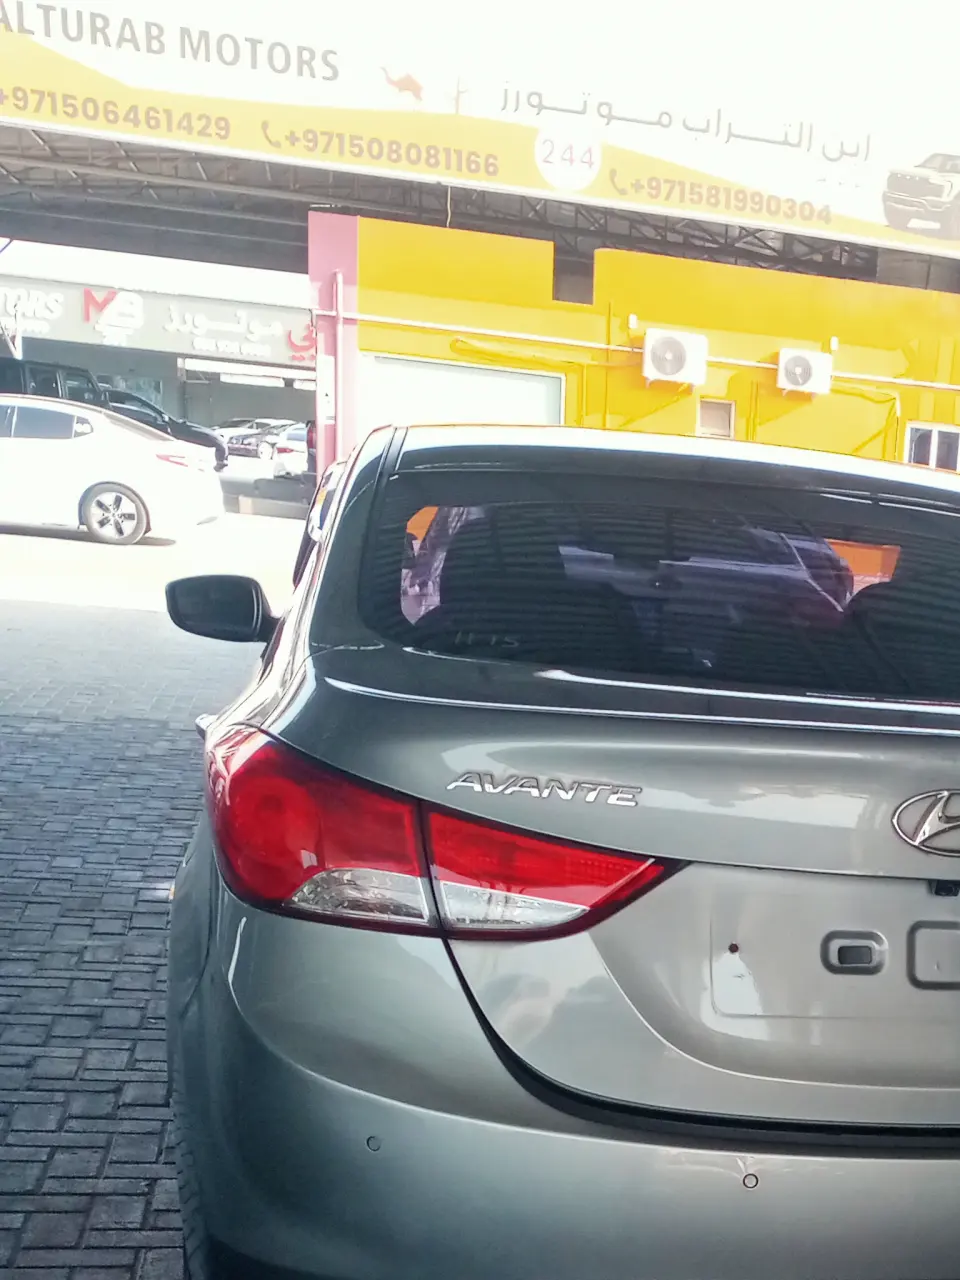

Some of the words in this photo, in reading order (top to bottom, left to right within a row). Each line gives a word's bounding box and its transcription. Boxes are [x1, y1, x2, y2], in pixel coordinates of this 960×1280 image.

[179, 26, 340, 82] MOTORS
[542, 139, 596, 169] 244
[446, 770, 643, 808] AVANTE
